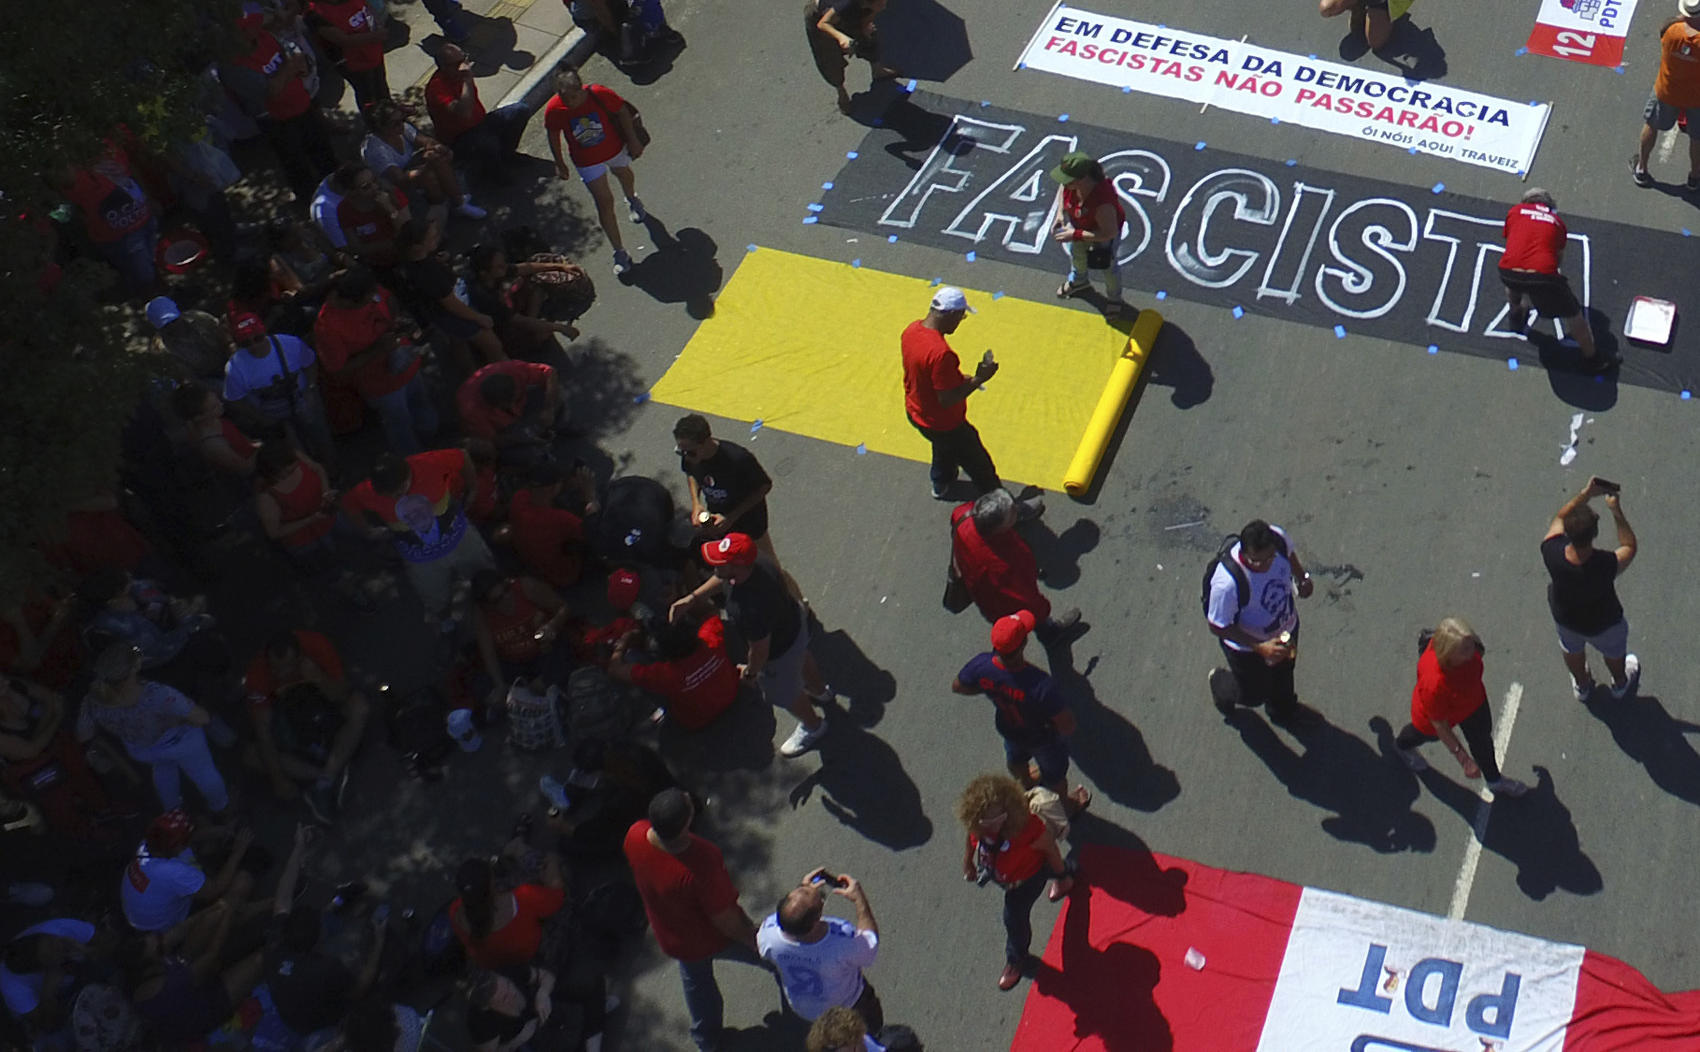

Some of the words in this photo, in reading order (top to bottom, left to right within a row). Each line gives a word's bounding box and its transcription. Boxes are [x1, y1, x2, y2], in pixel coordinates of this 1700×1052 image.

[1043, 35, 1204, 83] FASCISTAS
[1215, 70, 1284, 99] NÃO
[1293, 88, 1476, 141] PASSARÃO!
[1054, 15, 1102, 39] EM
[1110, 28, 1230, 66] DEFESA
[1240, 54, 1284, 78] DA
[1293, 65, 1511, 127] DEMOCRACIA
[1552, 31, 1596, 56] 12
[1380, 130, 1413, 147] NÓIS
[1417, 138, 1454, 156] AQUI
[1460, 146, 1520, 169] TRAVEIZ
[1336, 942, 1522, 1041] PDT
